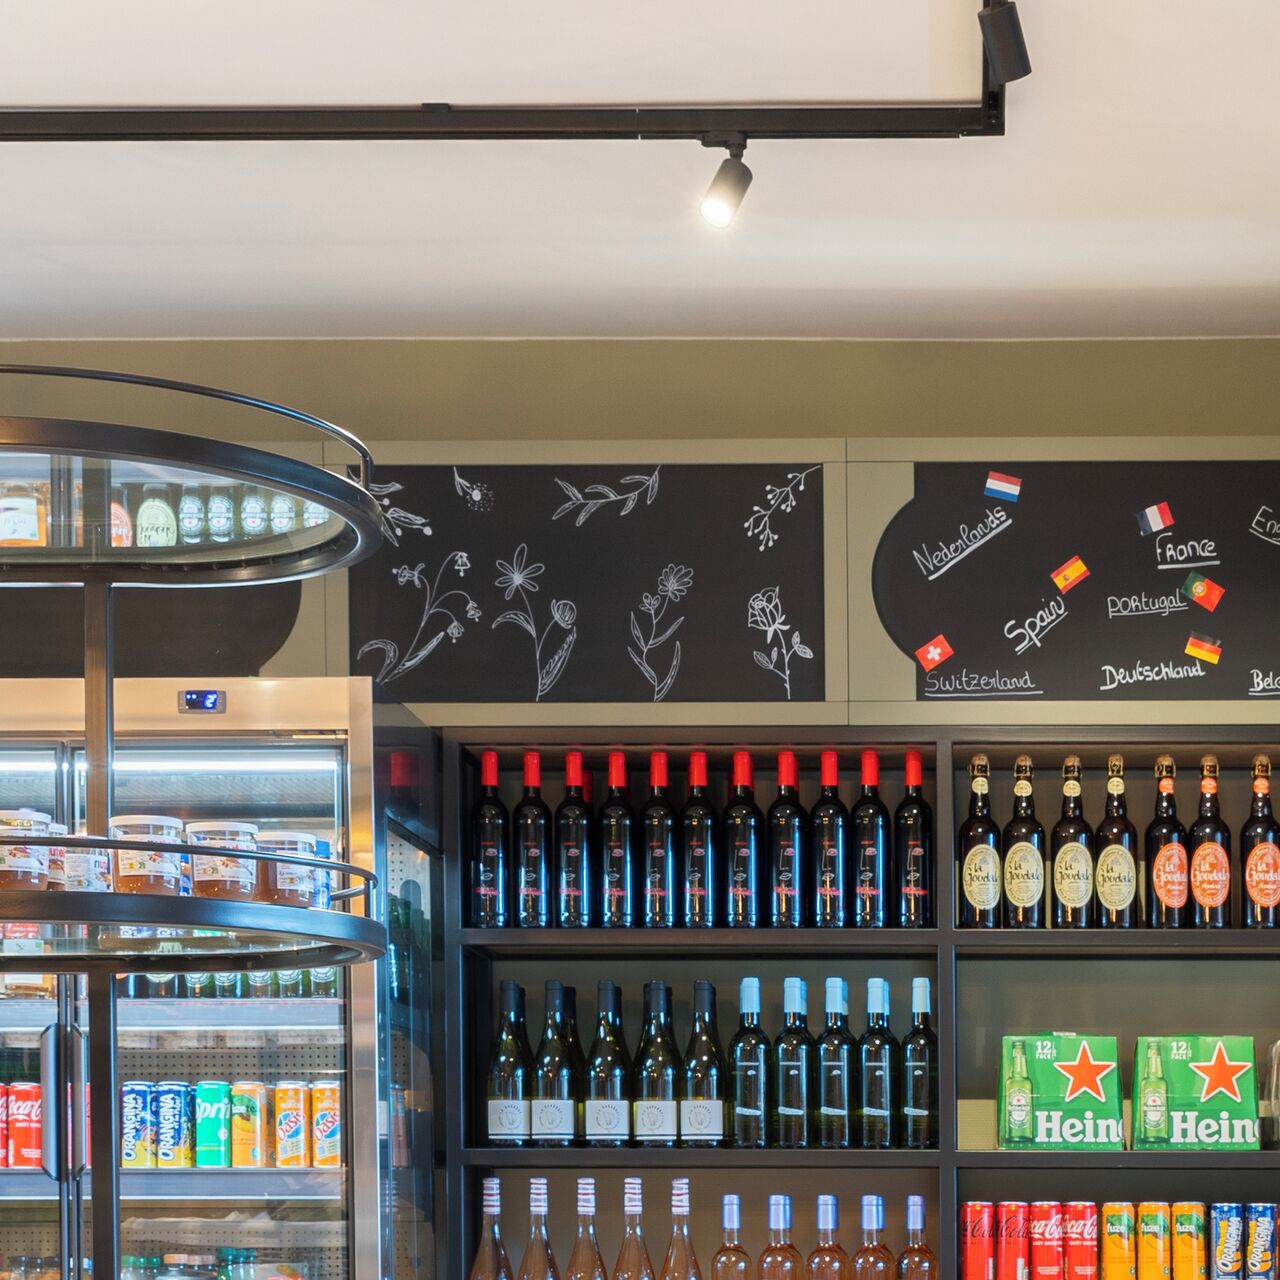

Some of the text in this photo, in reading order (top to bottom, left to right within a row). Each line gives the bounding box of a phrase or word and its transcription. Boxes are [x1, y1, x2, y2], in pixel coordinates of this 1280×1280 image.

[912, 506, 1007, 575] Nederlands
[1004, 596, 1065, 652] Spain
[925, 668, 1036, 691] Switzerland
[1100, 660, 1206, 690] Deutschland
[1036, 1041, 1051, 1052] 12
[1171, 1041, 1187, 1052] 12
[123, 1094, 136, 1160] ORANGINA
[158, 1094, 173, 1160] ORANGINA
[277, 1111, 306, 1141] Oasis
[1218, 1217, 1241, 1271] ORANGINA
[1248, 1217, 1269, 1271] ORANGINA
